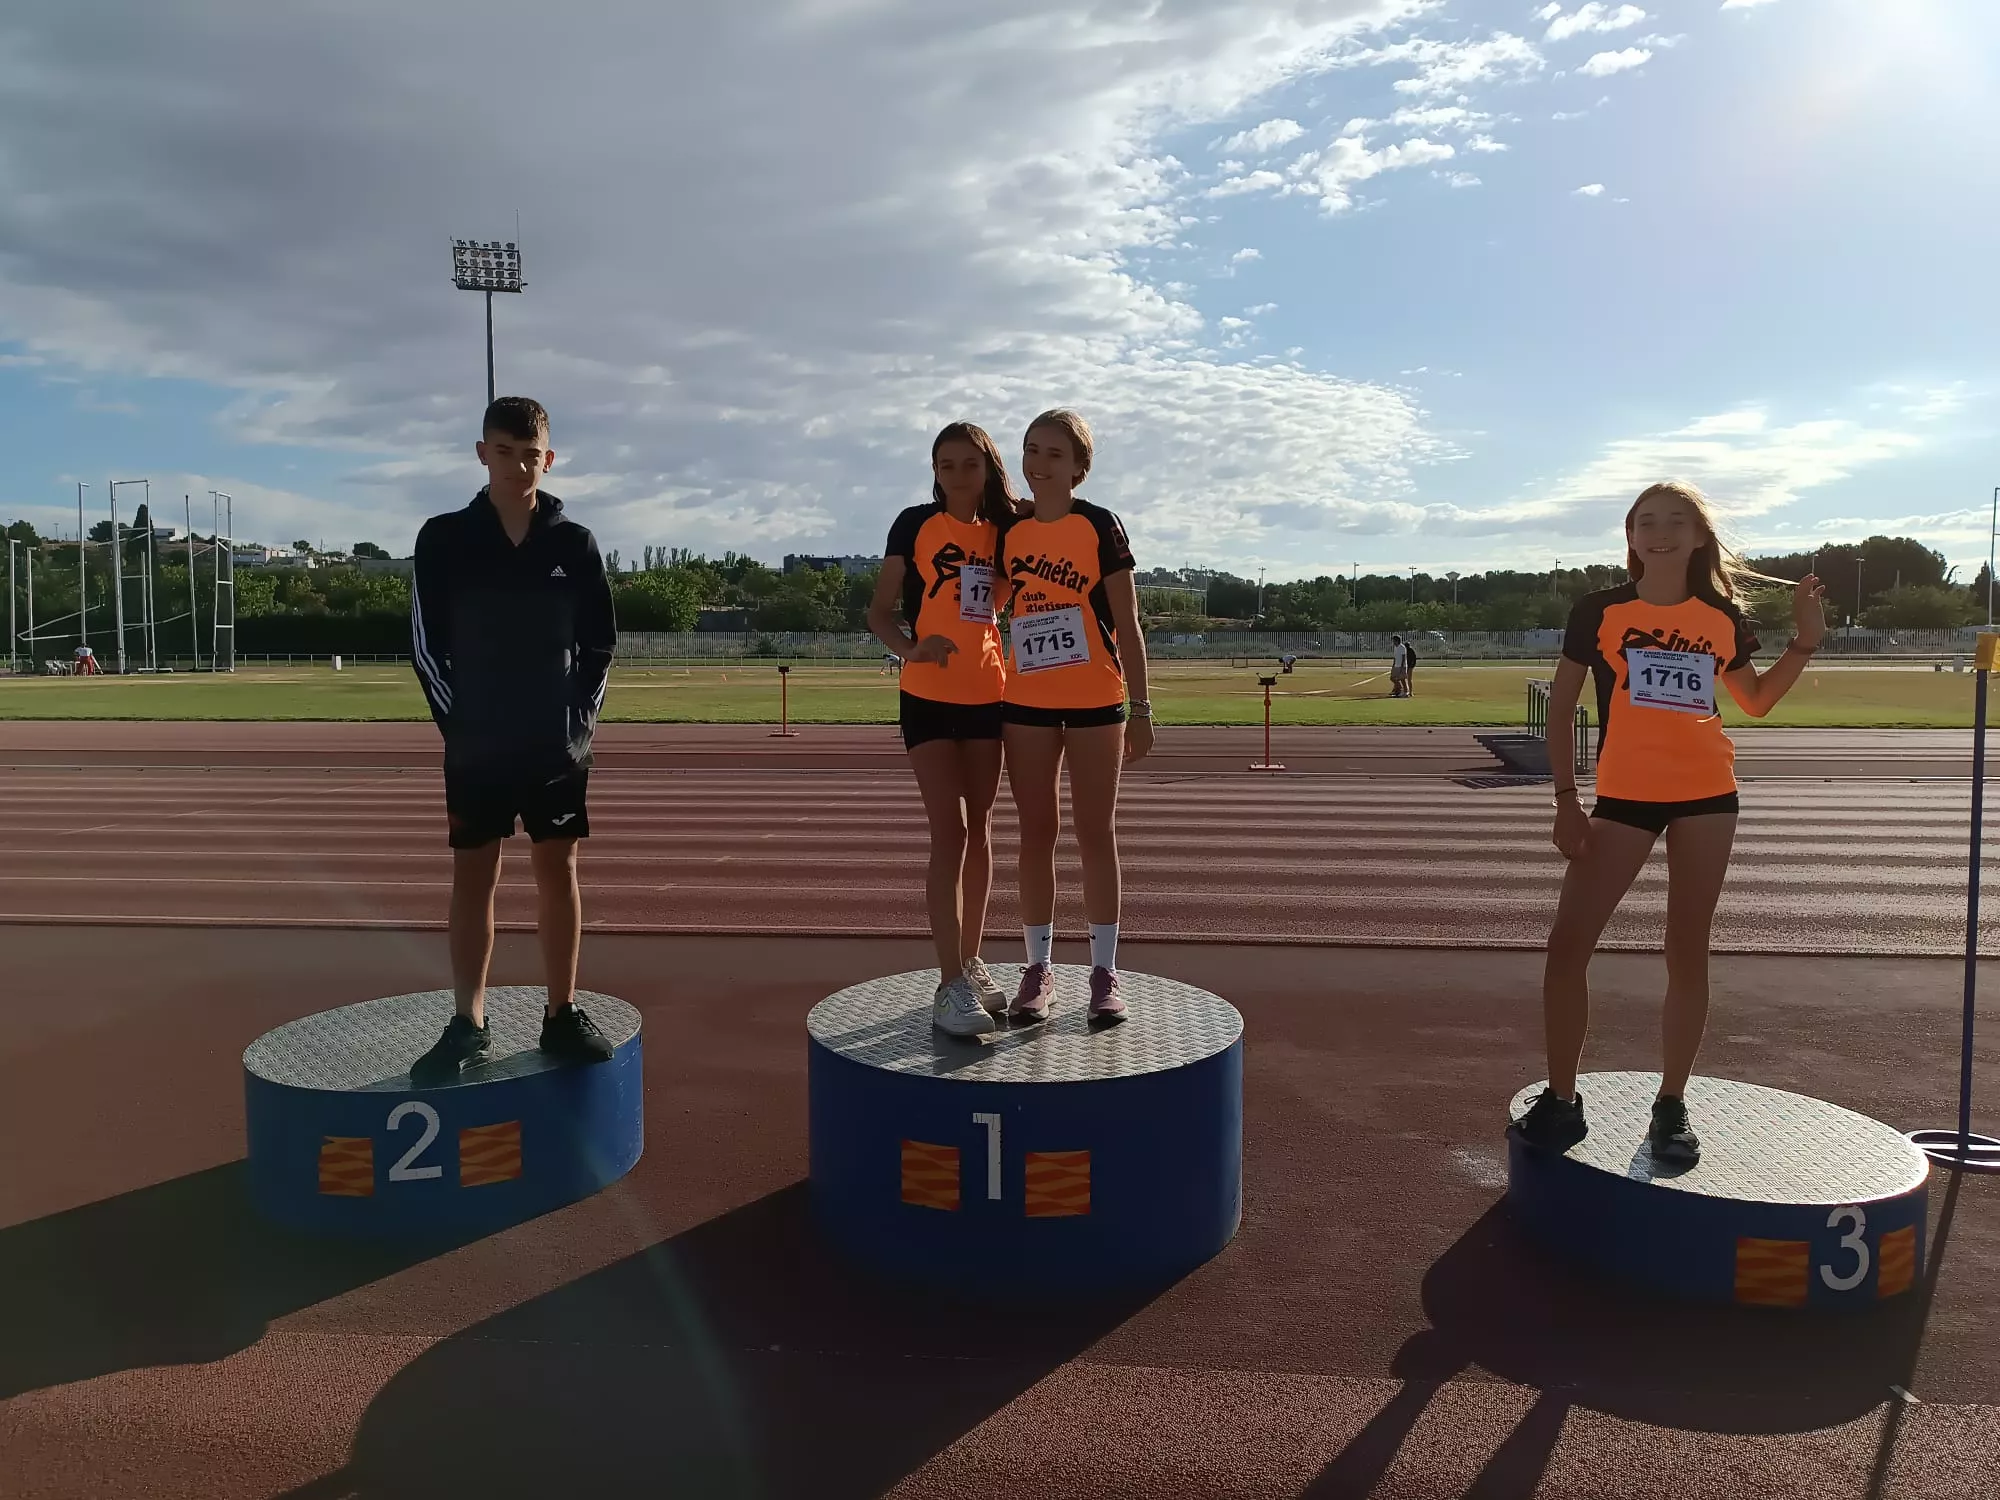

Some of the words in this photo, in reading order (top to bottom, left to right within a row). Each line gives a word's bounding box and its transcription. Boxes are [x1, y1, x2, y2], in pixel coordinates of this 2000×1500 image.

[1021, 591, 1047, 602] club
[1022, 631, 1075, 655] 1715
[1641, 667, 1702, 691] 1716
[387, 1101, 443, 1182] 2
[971, 1112, 1003, 1201] 1
[1819, 1206, 1870, 1291] 3
